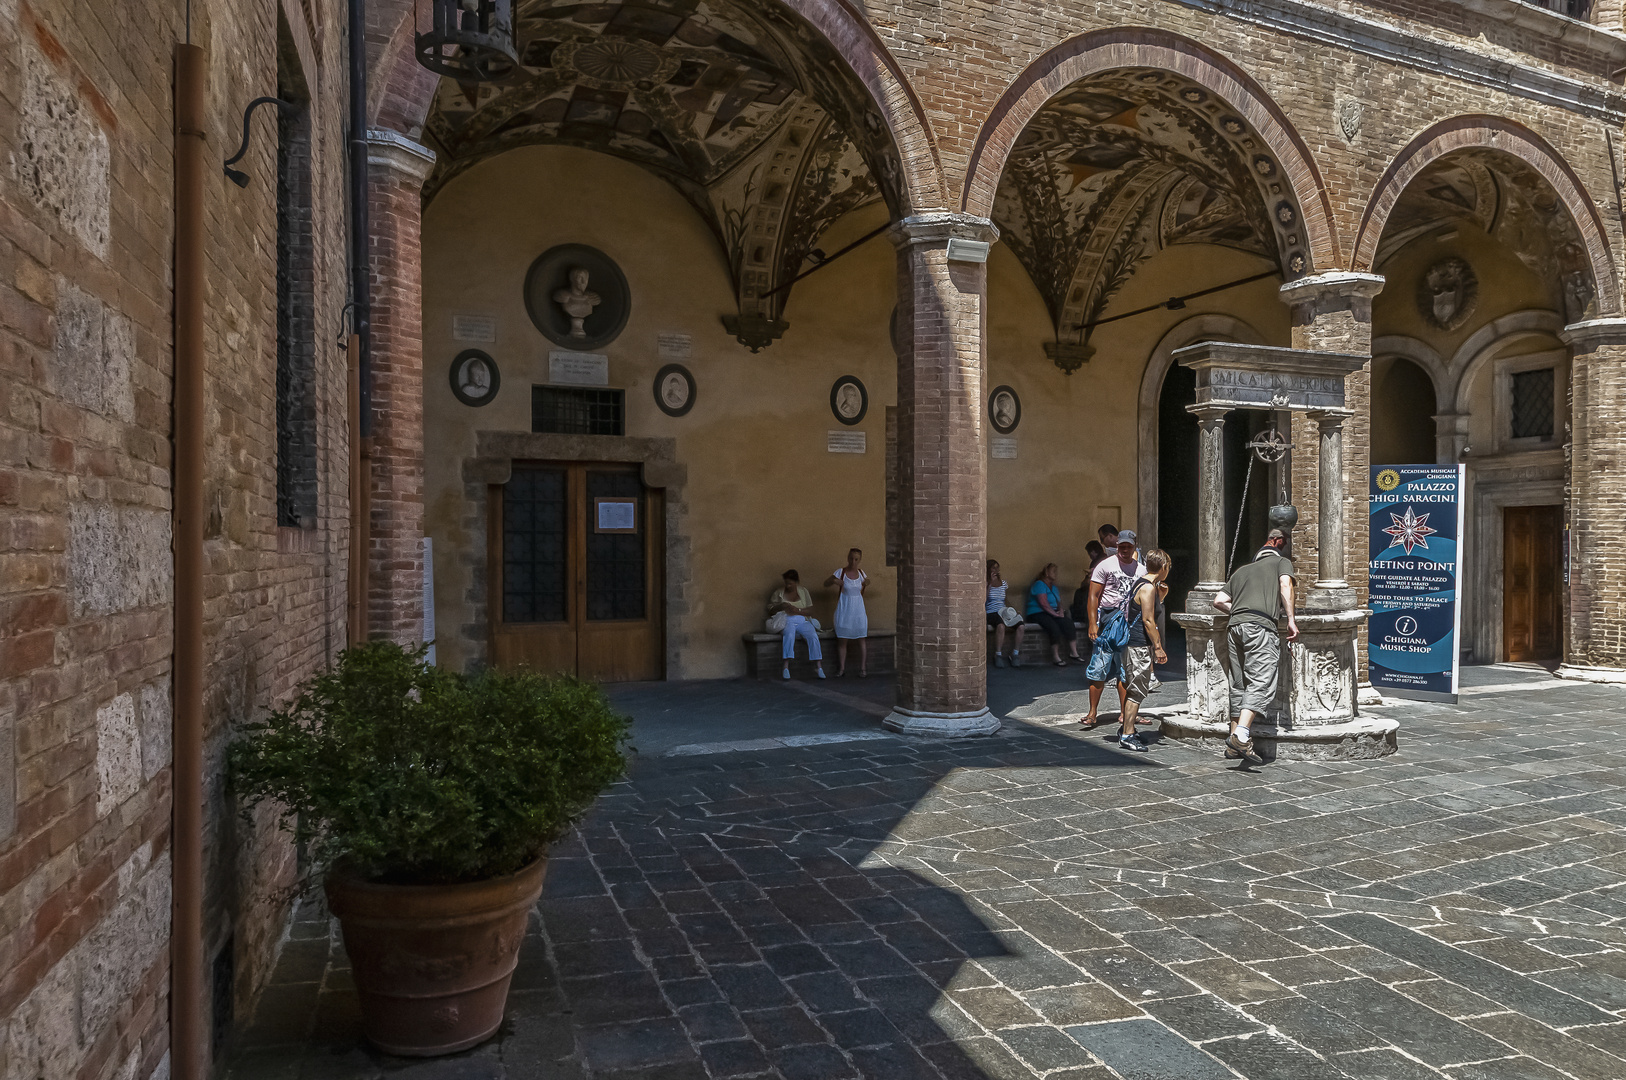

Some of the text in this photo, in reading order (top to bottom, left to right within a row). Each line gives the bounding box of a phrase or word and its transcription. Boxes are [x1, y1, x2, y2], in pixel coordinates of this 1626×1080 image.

[1271, 372, 1284, 388] IN
[1418, 562, 1455, 571] POINT
[1384, 635, 1427, 645] CHIGIANA
[1379, 643, 1406, 652] MUSIC
